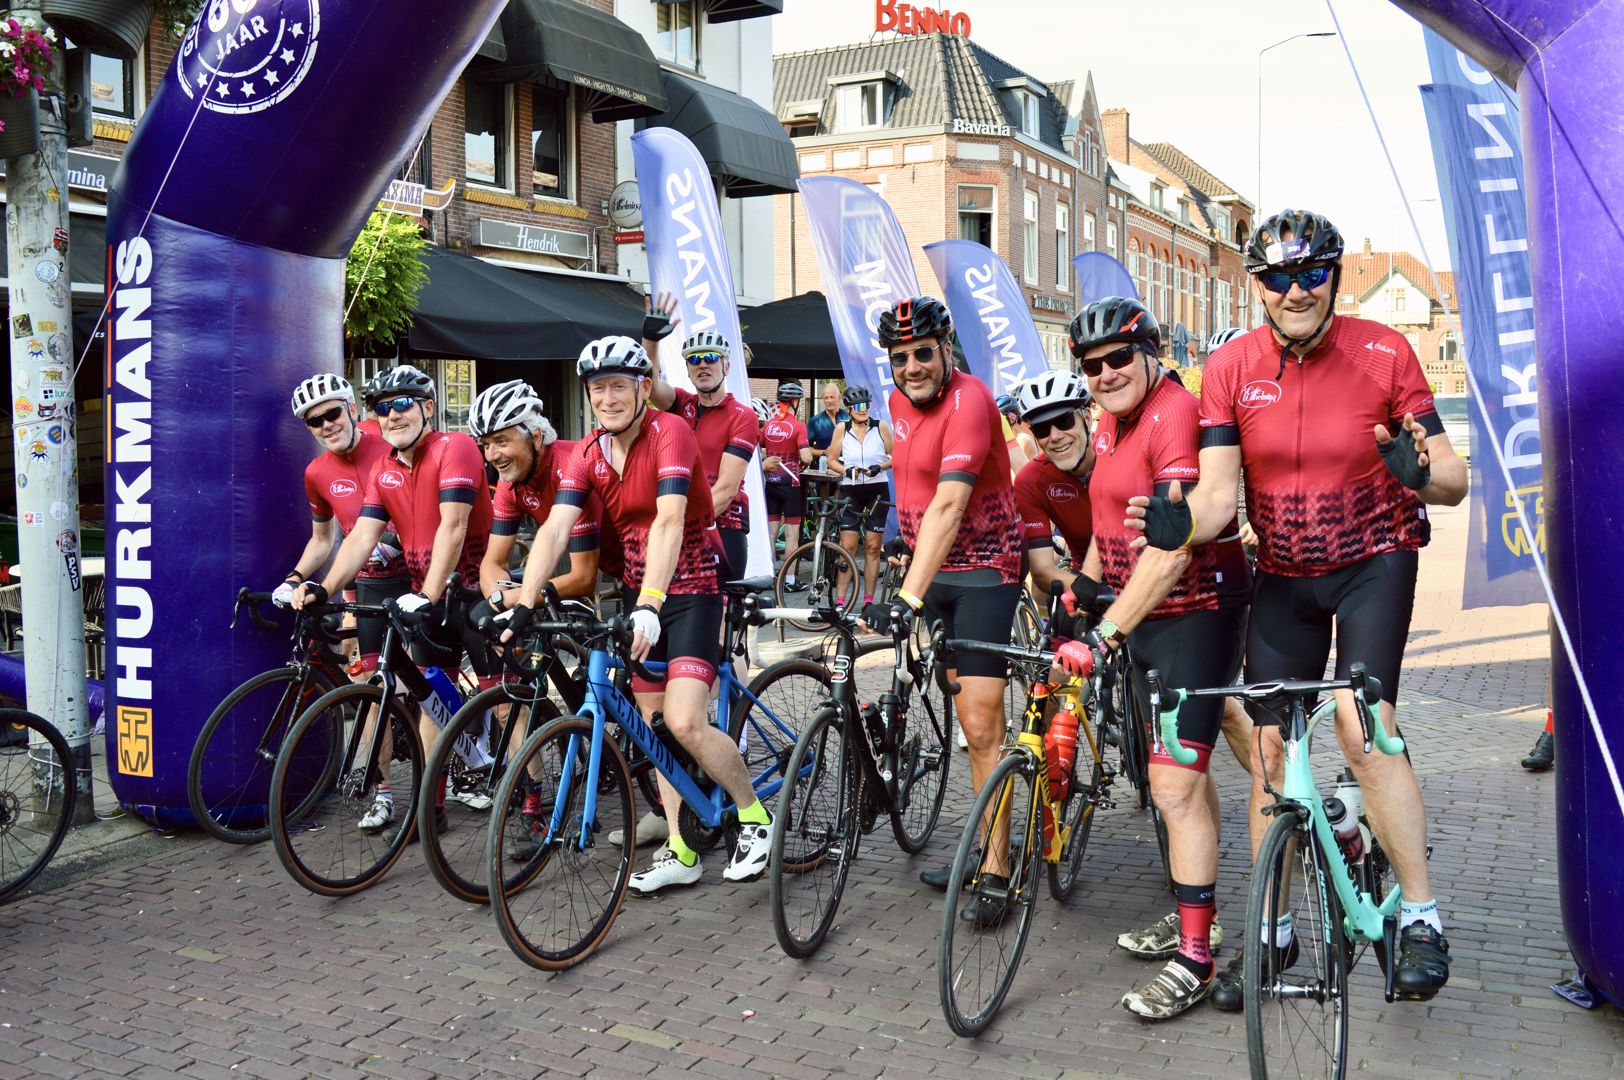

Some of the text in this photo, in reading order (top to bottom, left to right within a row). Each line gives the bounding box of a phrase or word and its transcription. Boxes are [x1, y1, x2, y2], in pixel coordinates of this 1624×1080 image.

[216, 15, 269, 60] JAAR
[875, 0, 971, 39] BENNO
[953, 118, 1011, 136] Bavaria
[517, 225, 560, 254] Hendrik
[116, 236, 154, 700] HURKMANS
[68, 556, 79, 590] PSV
[617, 694, 674, 776] CANYON
